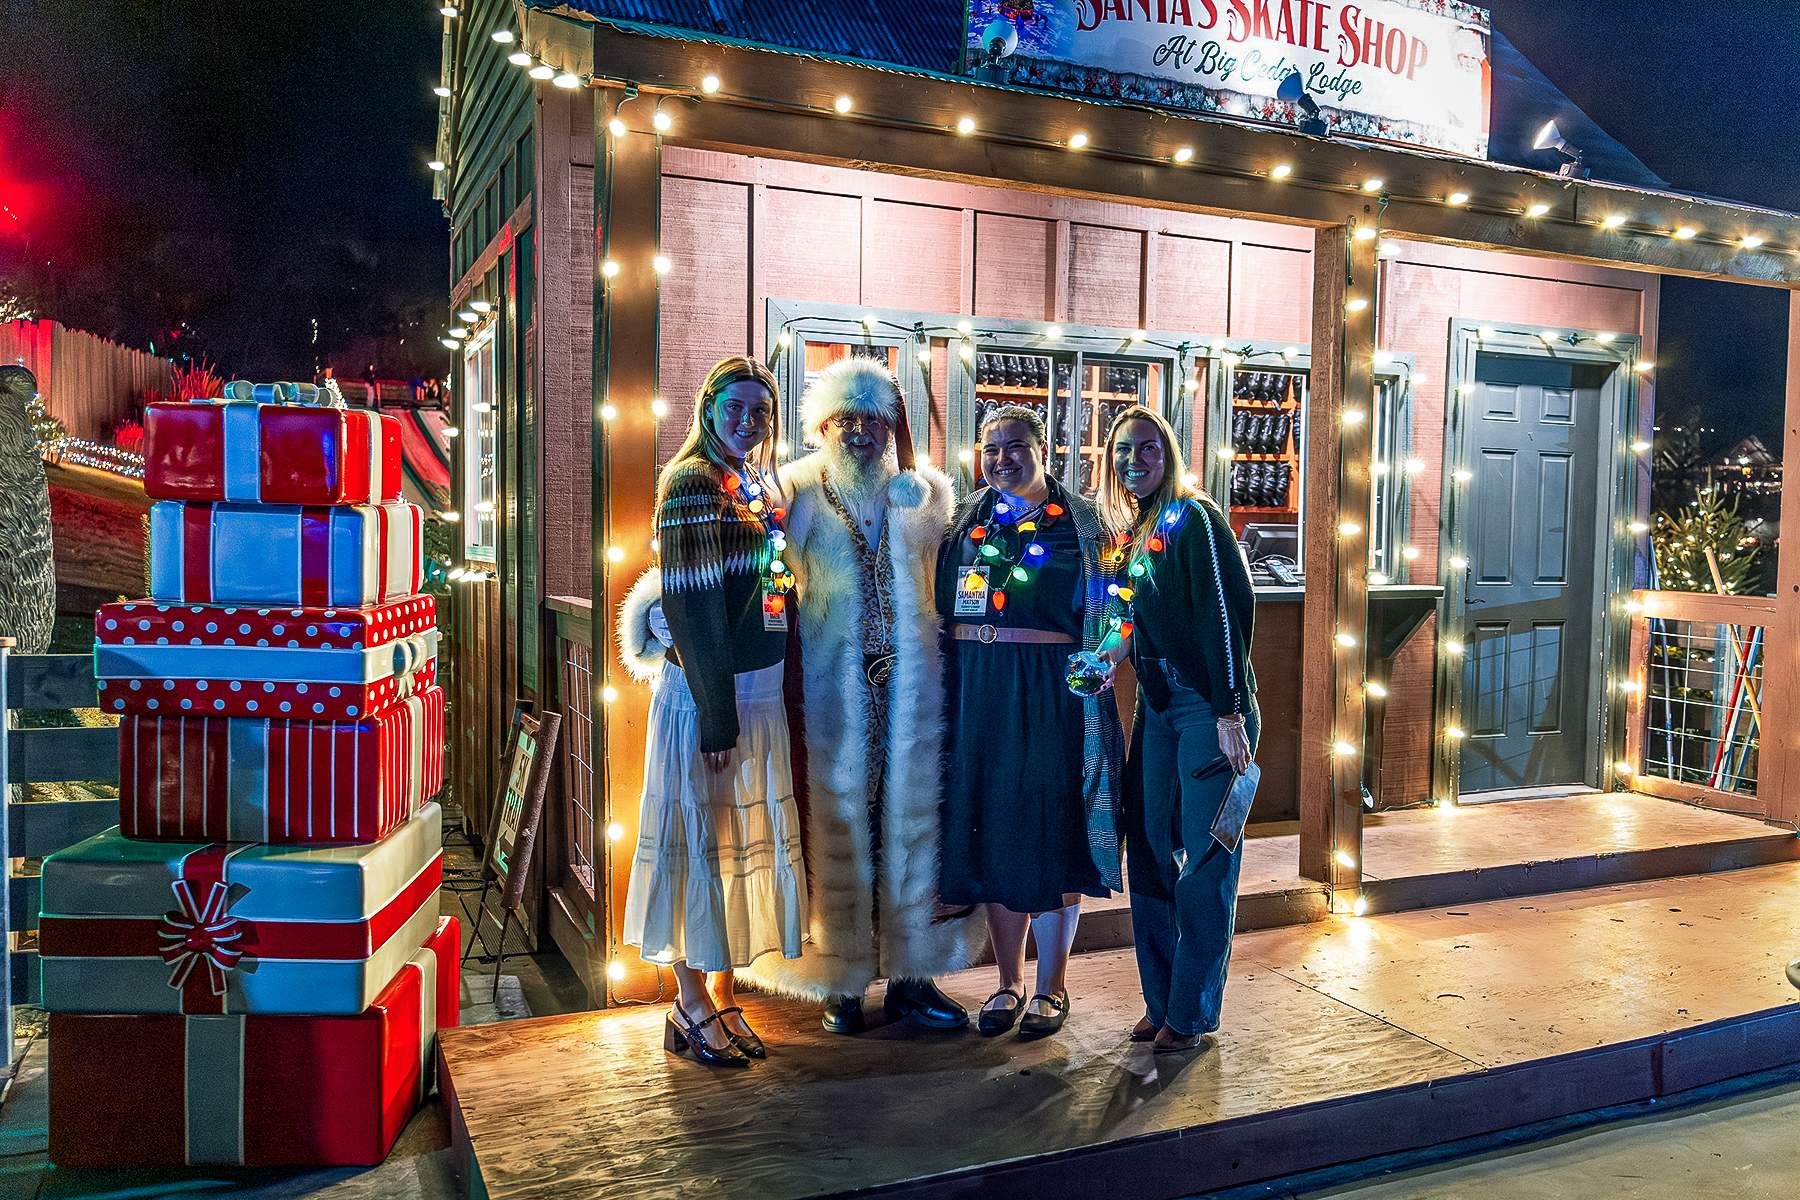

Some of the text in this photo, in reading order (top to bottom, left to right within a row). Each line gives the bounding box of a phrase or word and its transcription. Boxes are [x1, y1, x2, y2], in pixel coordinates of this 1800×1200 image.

[1153, 35, 1198, 69] At
[1194, 40, 1237, 82] Big
[1305, 62, 1362, 101] Lodge
[1226, 0, 1331, 54] SKATE
[1336, 4, 1428, 81] SHOP
